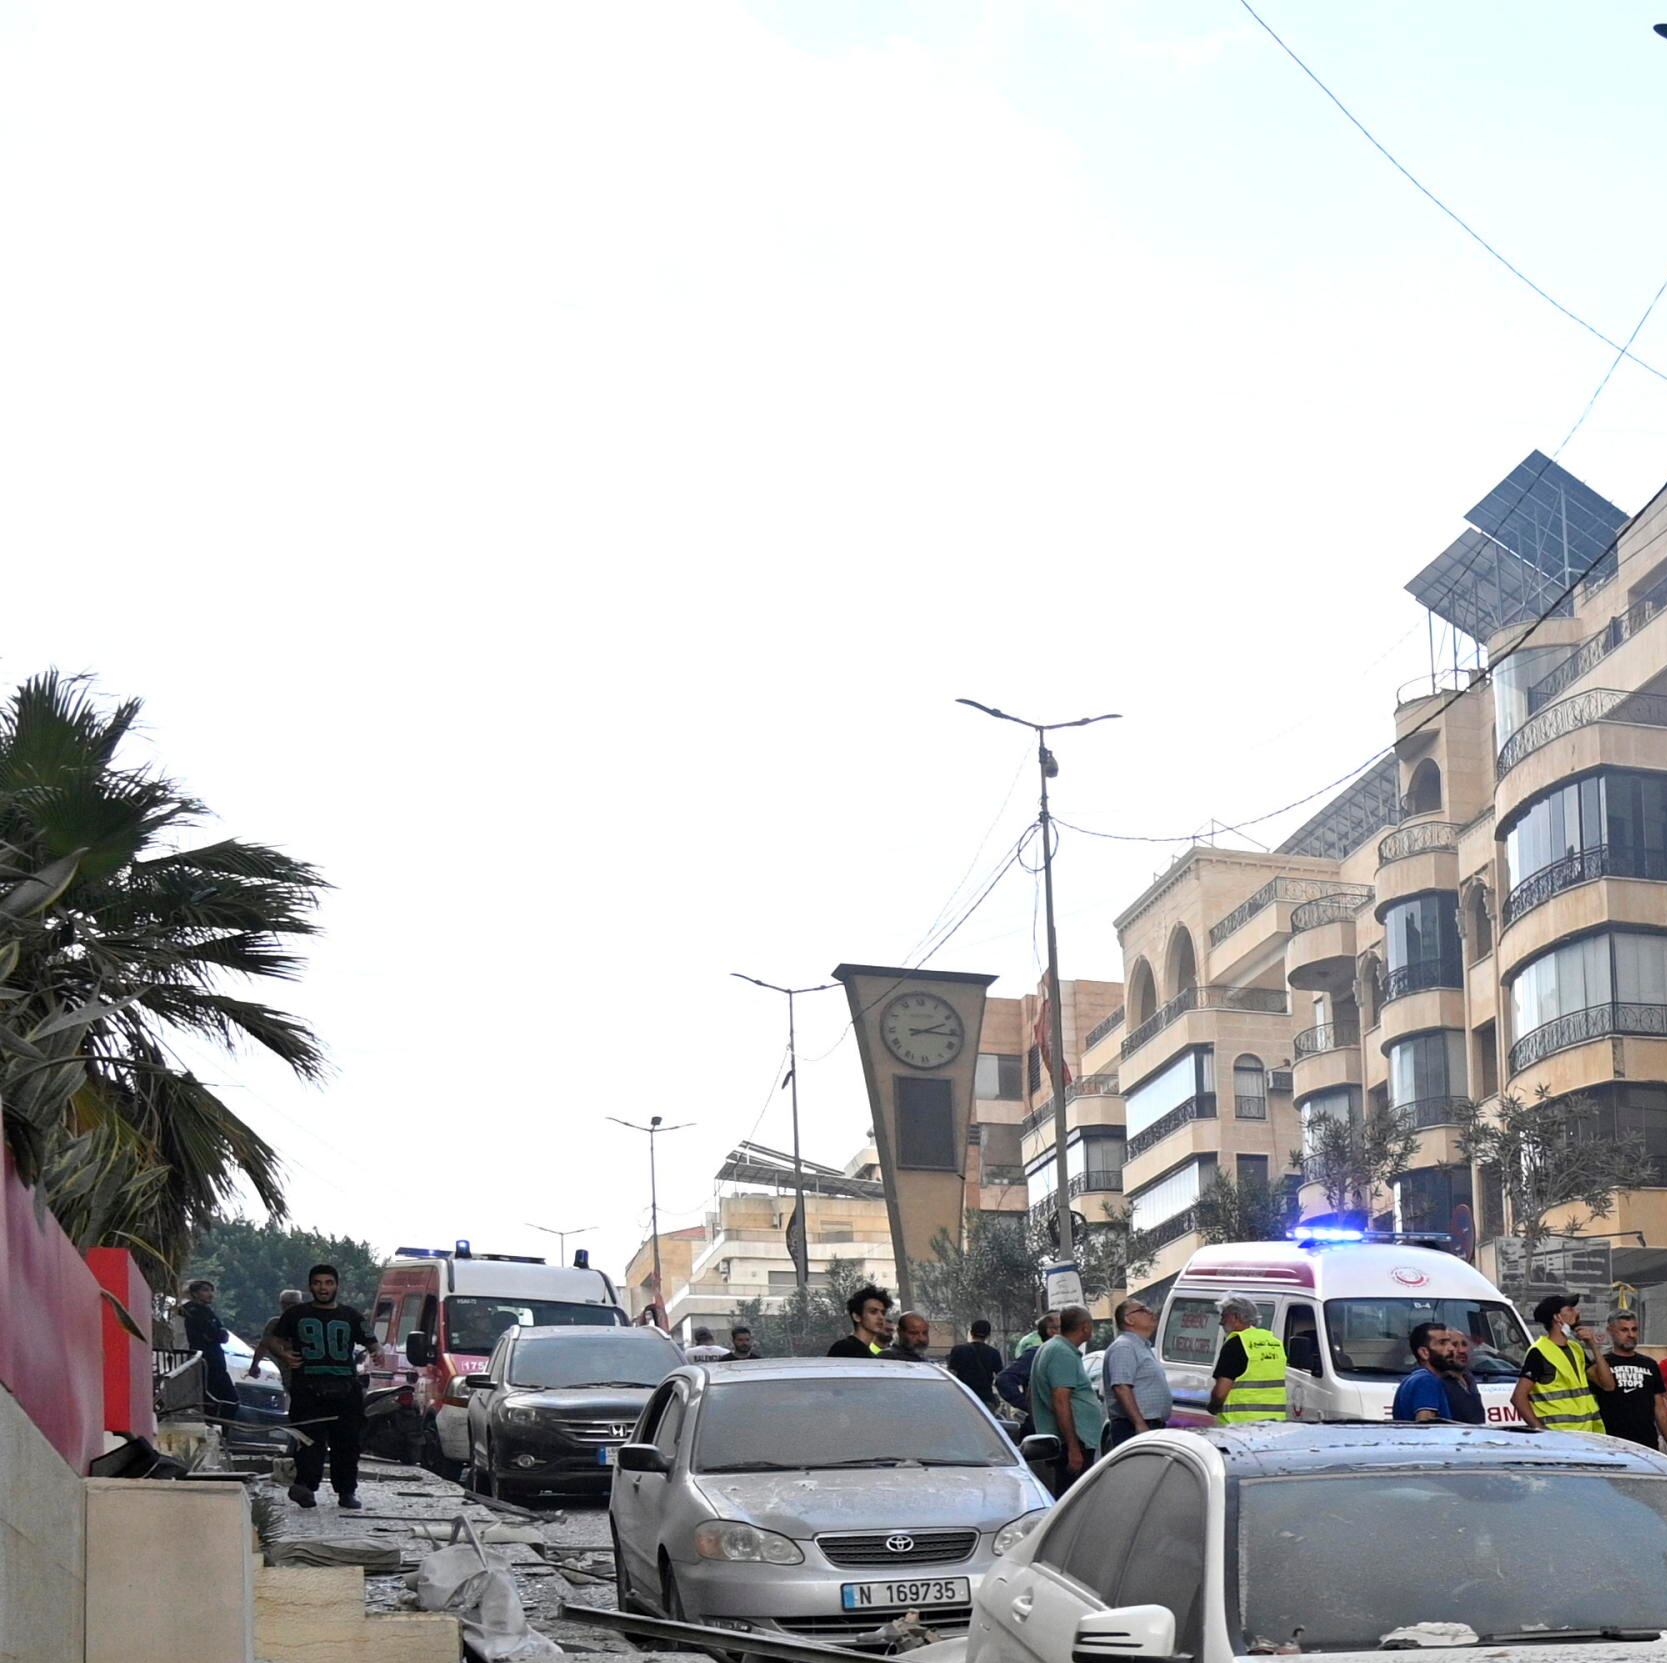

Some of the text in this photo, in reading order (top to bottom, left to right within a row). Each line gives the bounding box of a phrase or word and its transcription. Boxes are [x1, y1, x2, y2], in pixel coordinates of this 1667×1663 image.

[298, 1317, 352, 1361] 90
[1615, 1371, 1644, 1381] NEVER
[1618, 1380, 1644, 1388] STOPS
[859, 1581, 956, 1605] N 169735
